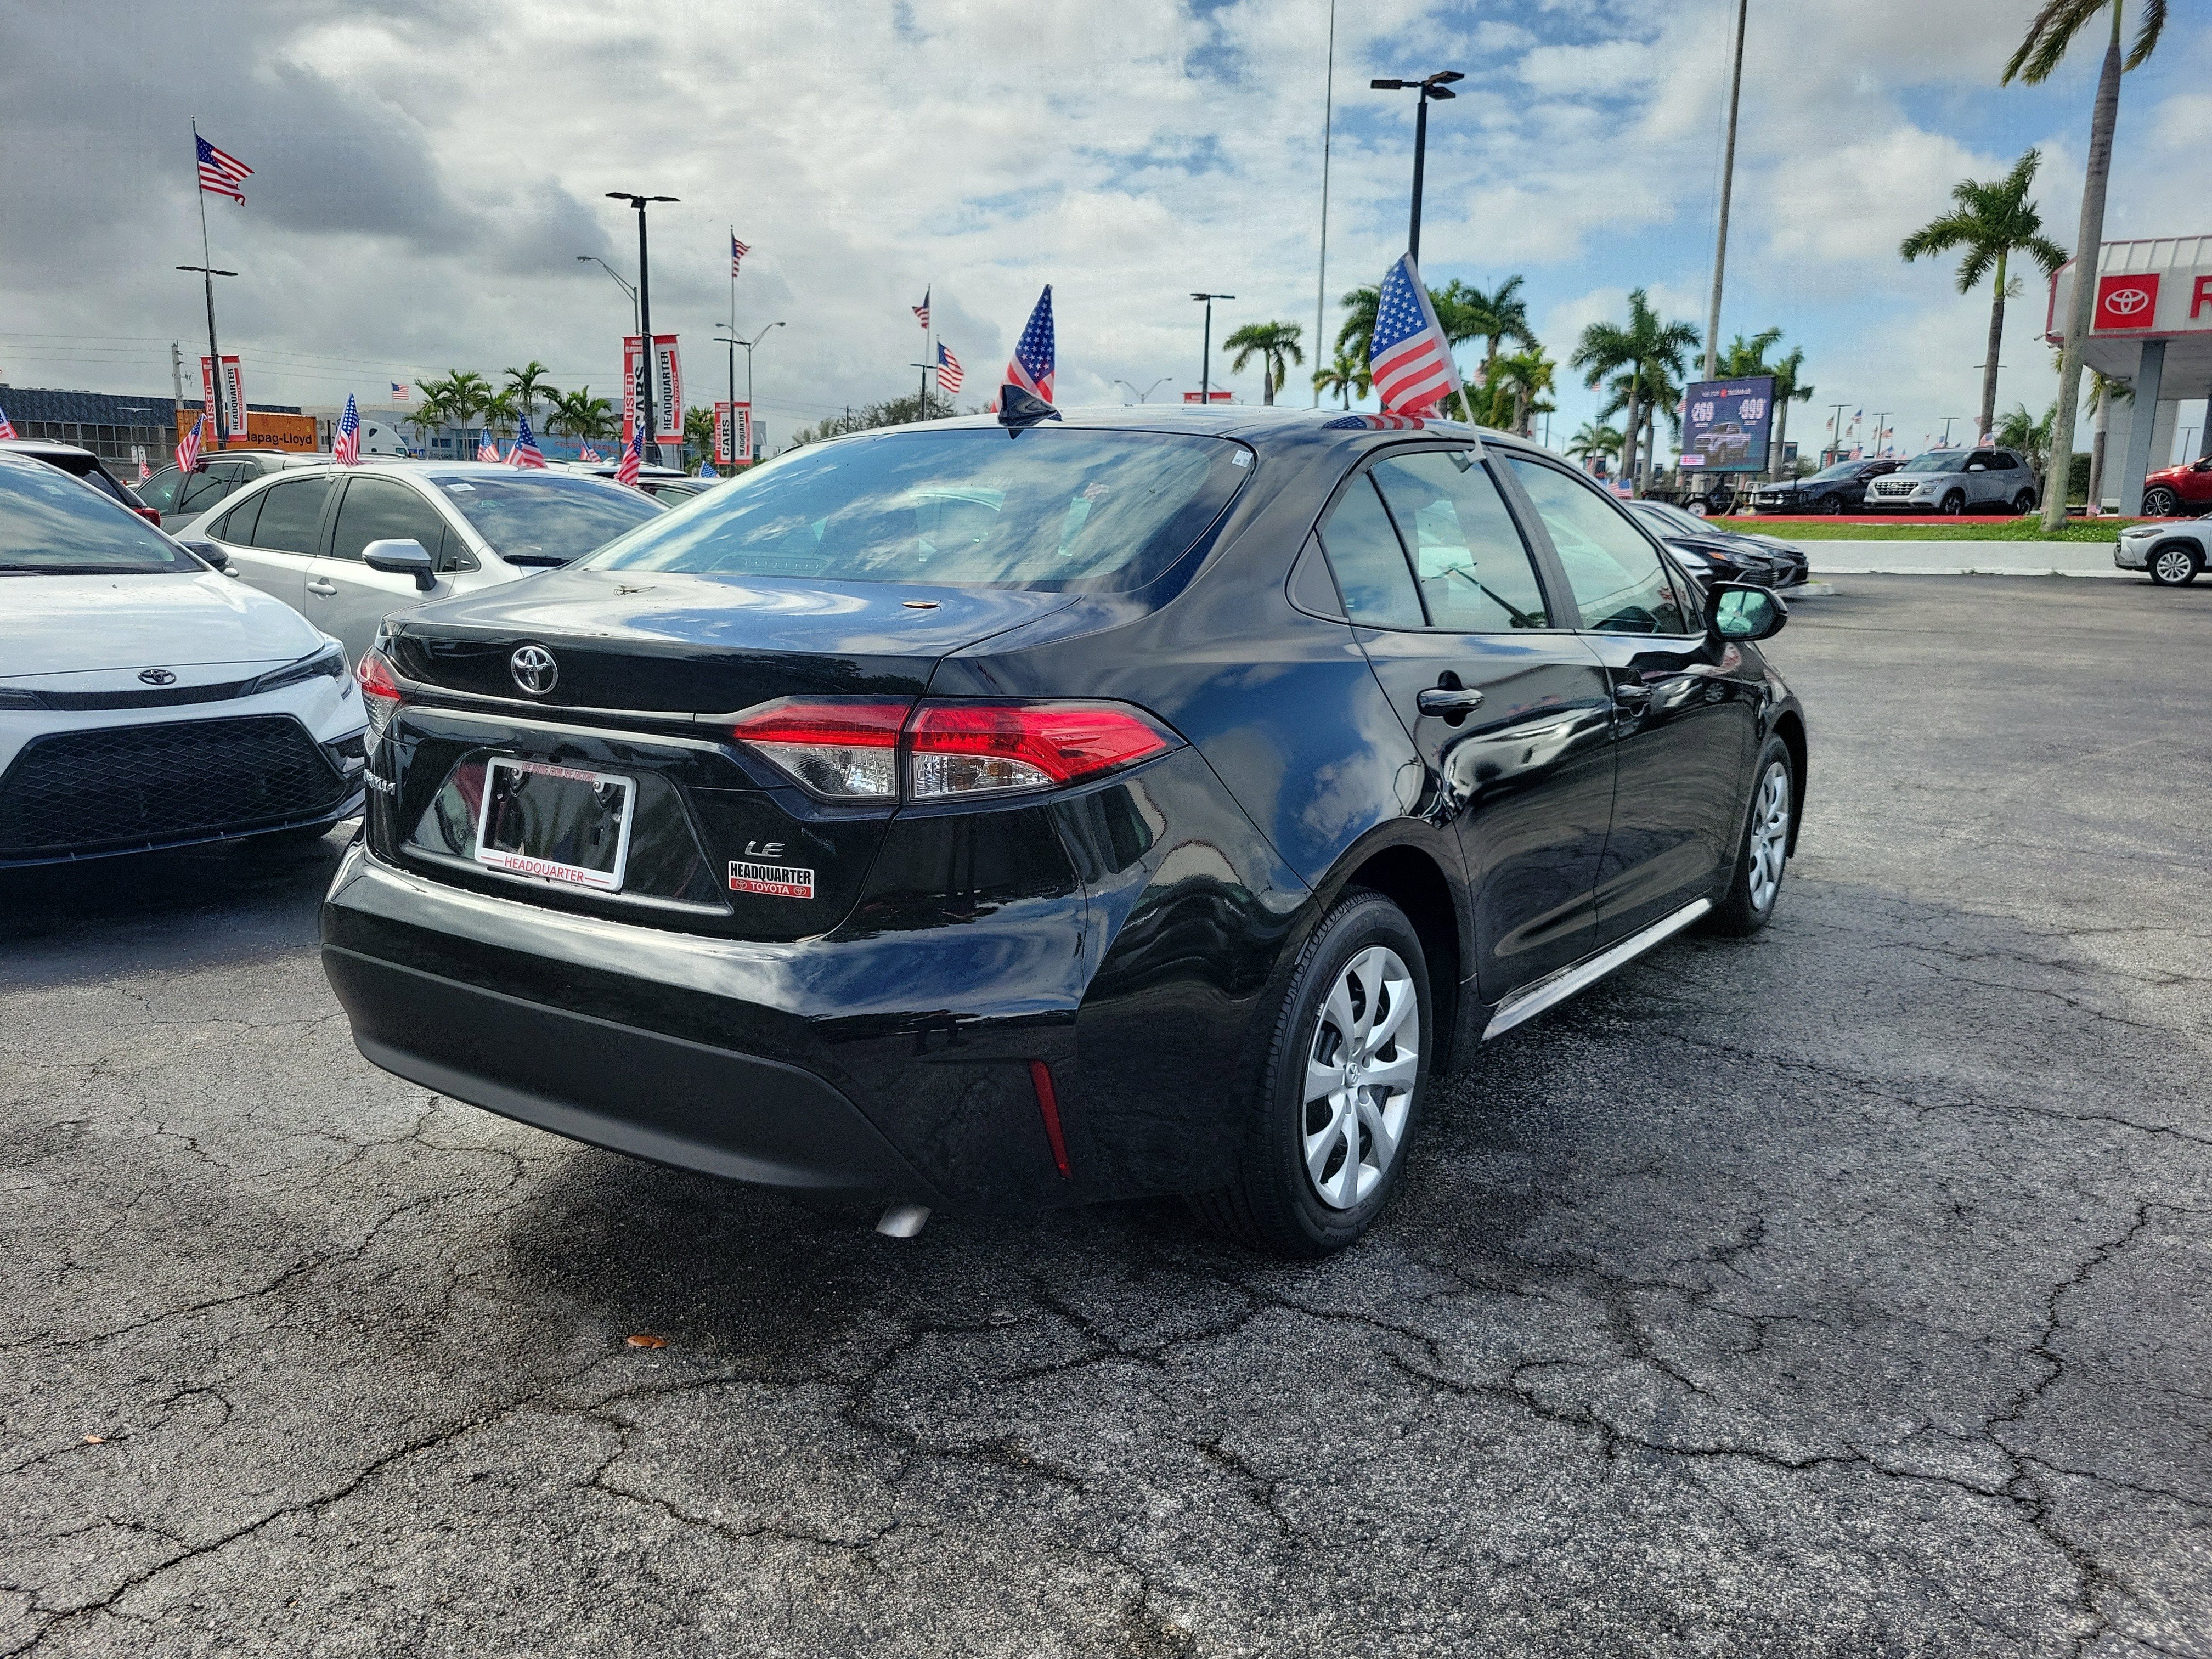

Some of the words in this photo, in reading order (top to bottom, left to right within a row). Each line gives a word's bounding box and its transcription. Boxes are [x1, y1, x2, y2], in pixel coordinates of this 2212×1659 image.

[227, 368, 239, 430] HEADQUARTER
[661, 351, 673, 430] HEADQUARTER
[206, 386, 215, 421] USED
[247, 431, 312, 446] apag-Lloyd
[744, 841, 785, 857] LE
[504, 856, 585, 882] HEADQUARTER
[731, 862, 811, 885] HEADQUARTER
[751, 882, 789, 894] TOYOTA
